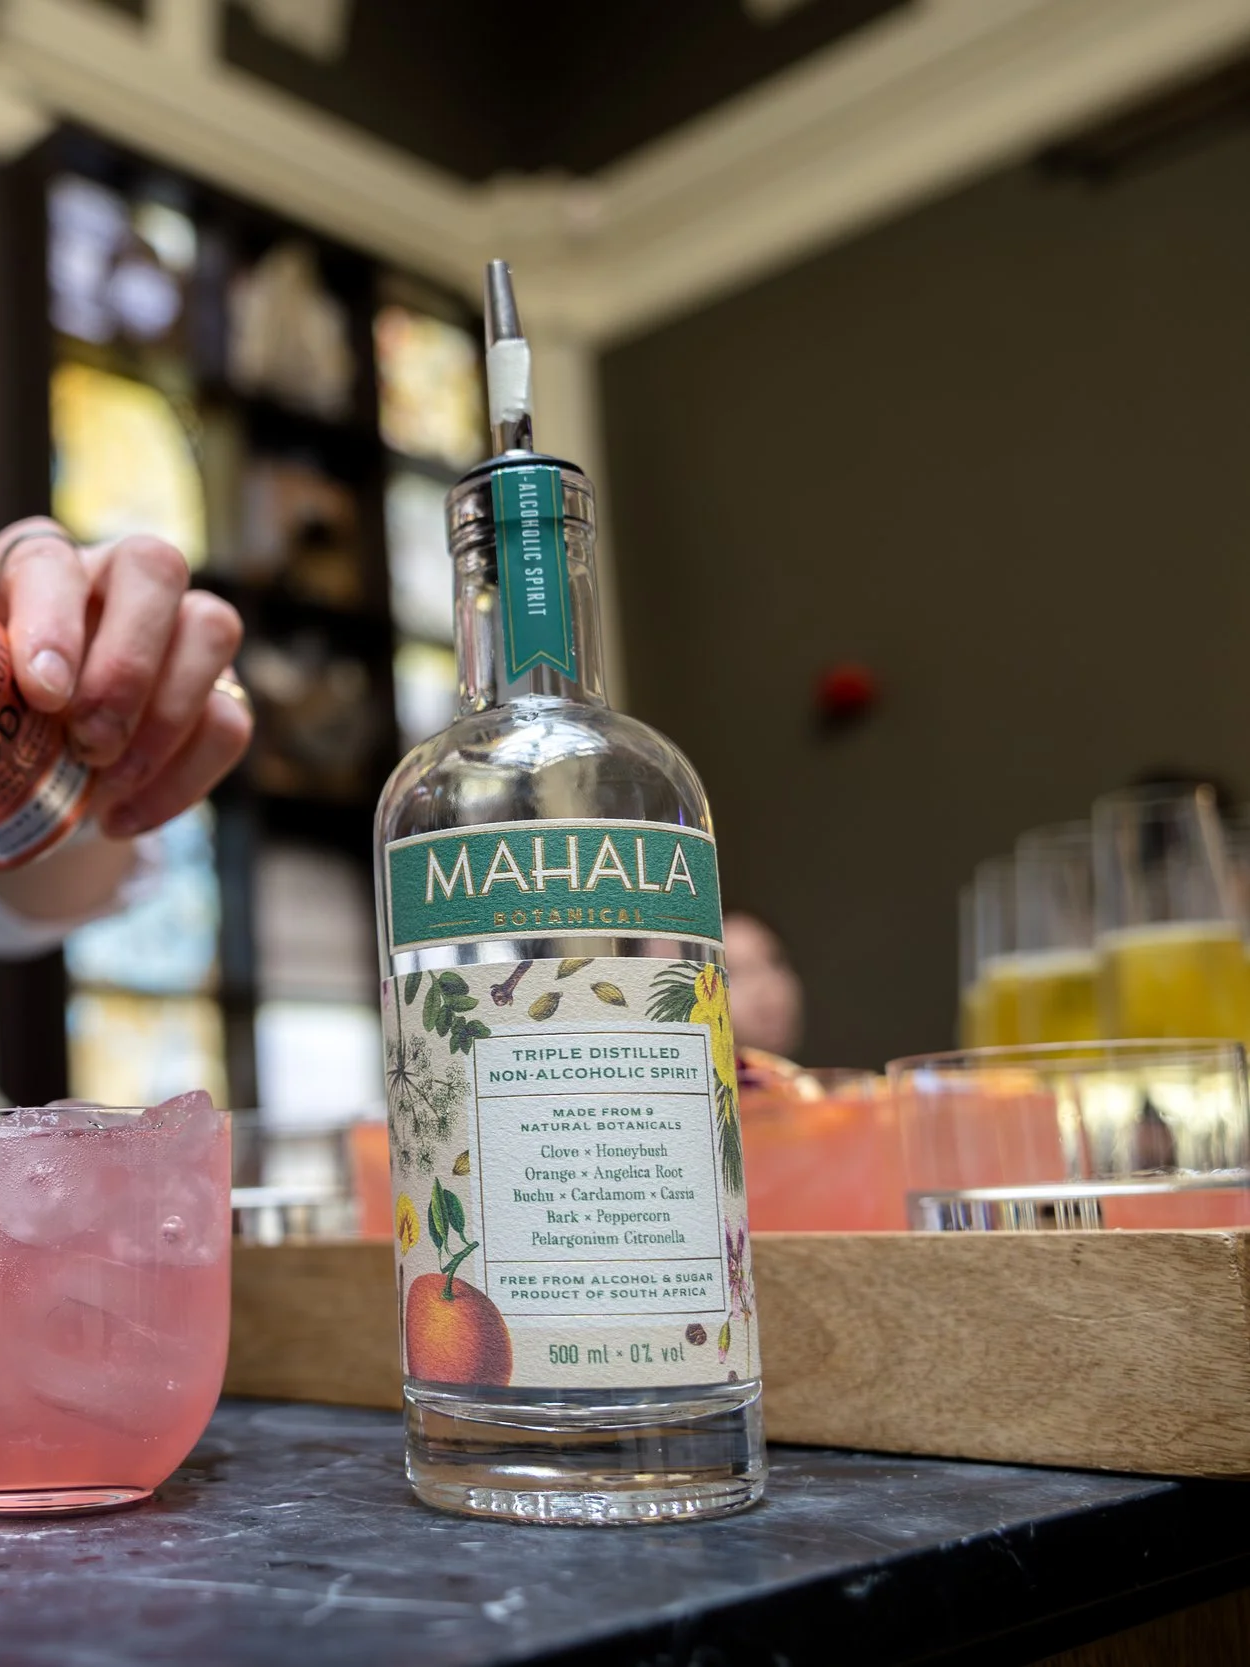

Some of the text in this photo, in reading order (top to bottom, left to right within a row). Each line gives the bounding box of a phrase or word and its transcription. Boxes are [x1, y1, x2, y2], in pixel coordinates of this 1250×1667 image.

[524, 567, 547, 616] SPIRIT
[424, 833, 698, 904] MAHALA
[493, 907, 645, 926] BOTANICAL
[512, 1046, 680, 1061] TRIPLE DISTILLED
[489, 1066, 698, 1083] NON-ALCOHOLIC SPIRIT
[552, 1107, 654, 1118] MADE FROM 9
[520, 1120, 682, 1133] NATURAL BOTANICALS
[540, 1144, 579, 1159] Clove
[595, 1144, 668, 1160] Honeybush
[524, 1166, 576, 1183] Orange
[593, 1165, 650, 1183] Angelica
[655, 1164, 683, 1179] Root
[513, 1188, 554, 1203] Buchu
[570, 1186, 646, 1202] Cardamom
[660, 1186, 695, 1201] Cassia
[546, 1209, 579, 1224] Bark
[596, 1208, 671, 1226] Peppercorn
[531, 1230, 685, 1249] Pelargonium Citronella
[500, 1272, 713, 1286] FREE FROM ALCOHOL & SUGAR
[511, 1287, 707, 1300] PRODUCT OF SOUTH AFRICA
[549, 1343, 580, 1365] 500
[587, 1343, 609, 1364] ml
[630, 1343, 653, 1364] 0%
[661, 1342, 686, 1363] vol
